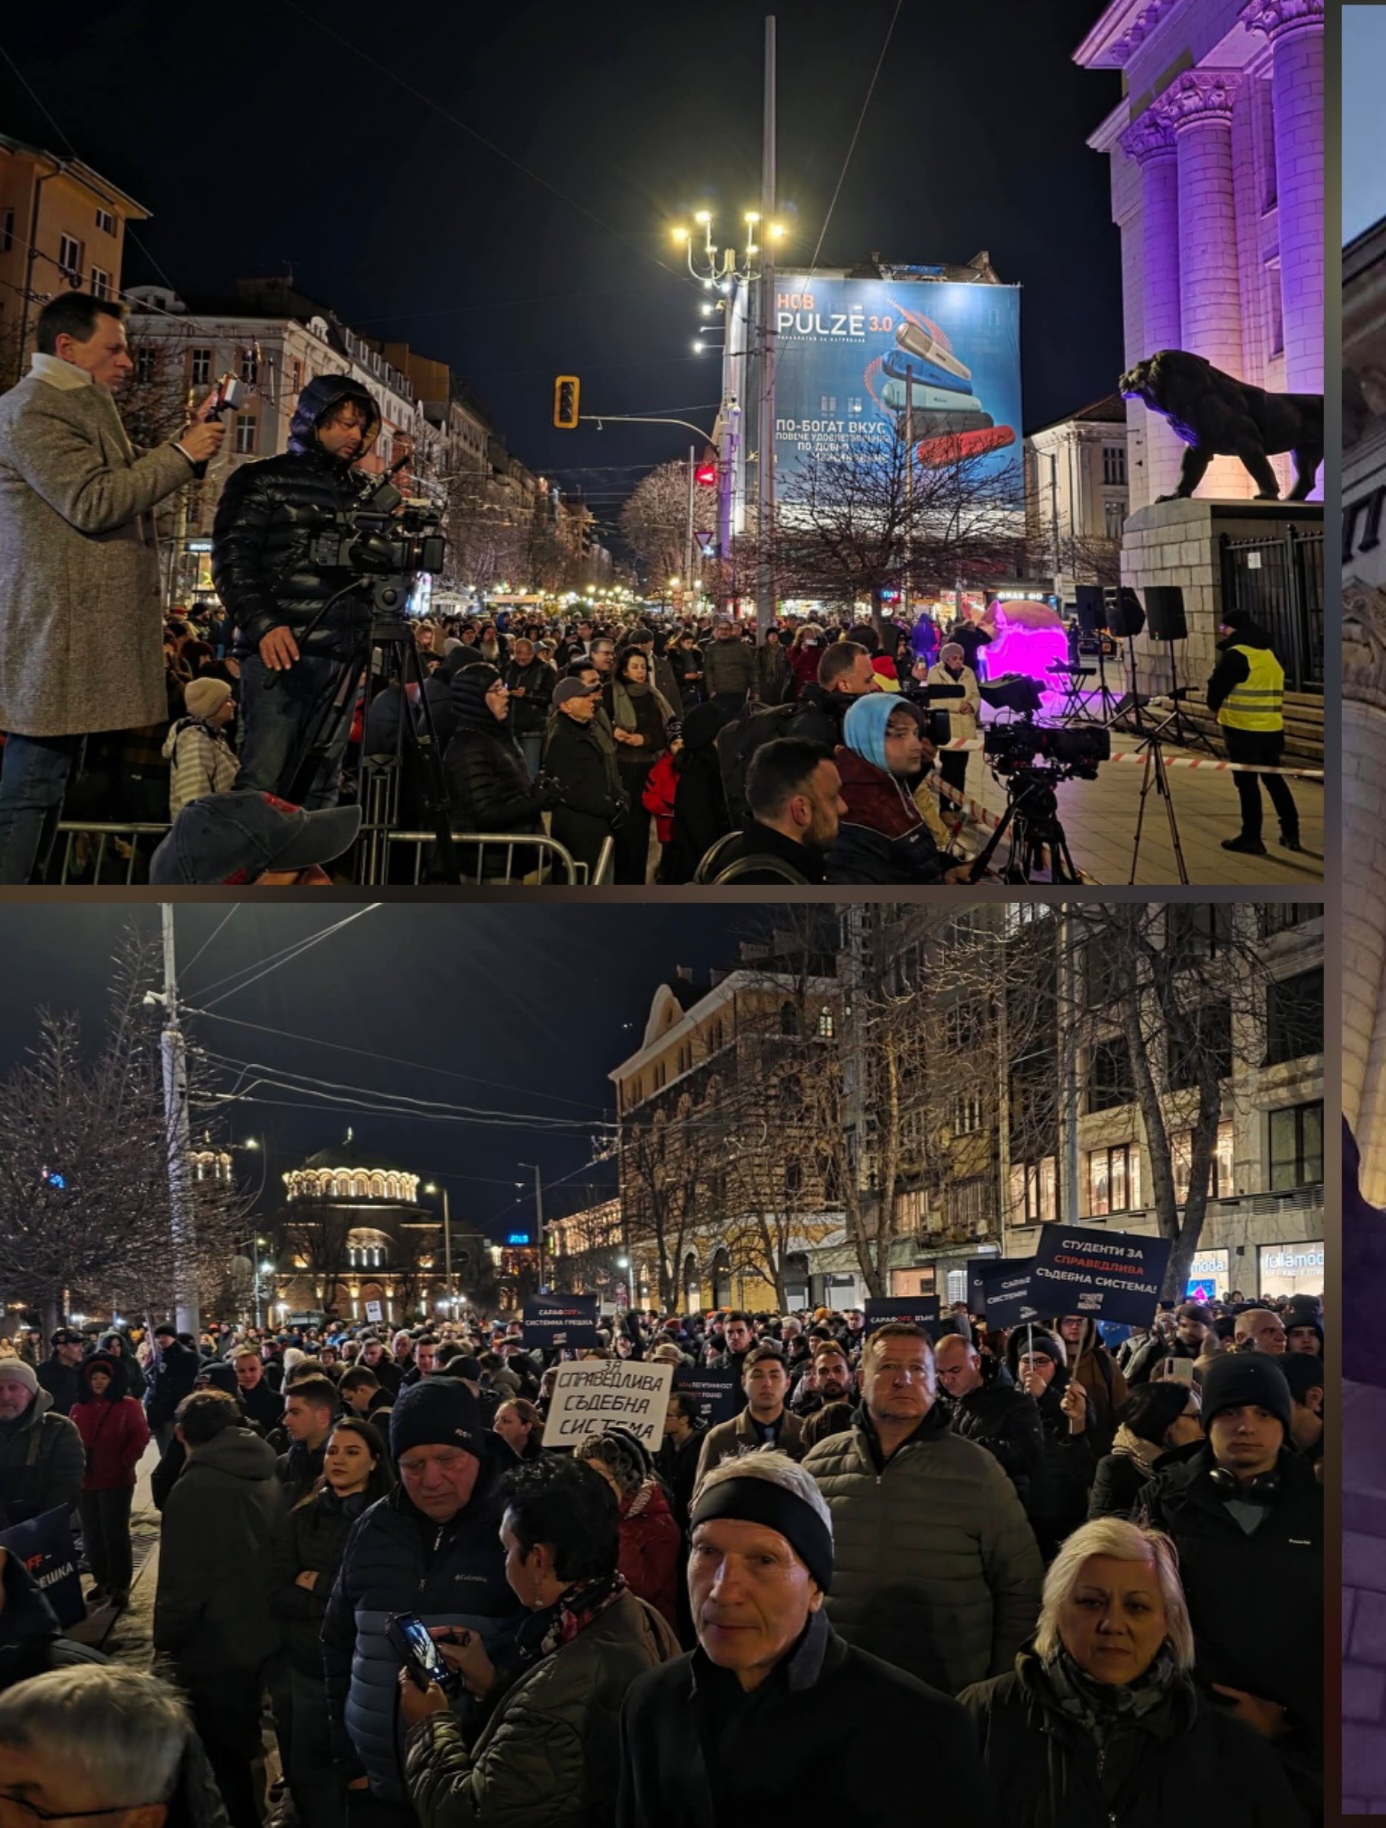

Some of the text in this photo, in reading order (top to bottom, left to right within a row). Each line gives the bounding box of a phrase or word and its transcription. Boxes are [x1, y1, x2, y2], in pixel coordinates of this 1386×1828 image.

[777, 294, 814, 310] НОВ
[869, 316, 893, 332] 3.0
[776, 419, 885, 434] ПО-БОГАТ ВКУС
[1062, 1240, 1144, 1260] СТУДЕНТИ ЗА
[1054, 1254, 1145, 1276] СПРАВЕДЛИВА
[1036, 1267, 1159, 1294] СЪДЕБНА СИСТЕМА!
[602, 1360, 622, 1373] ЗА
[558, 1371, 664, 1392] СПРАВЕДЛИВА
[564, 1394, 650, 1414] СЪДЕБНА
[38, 1562, 74, 1589] ЕШКА
